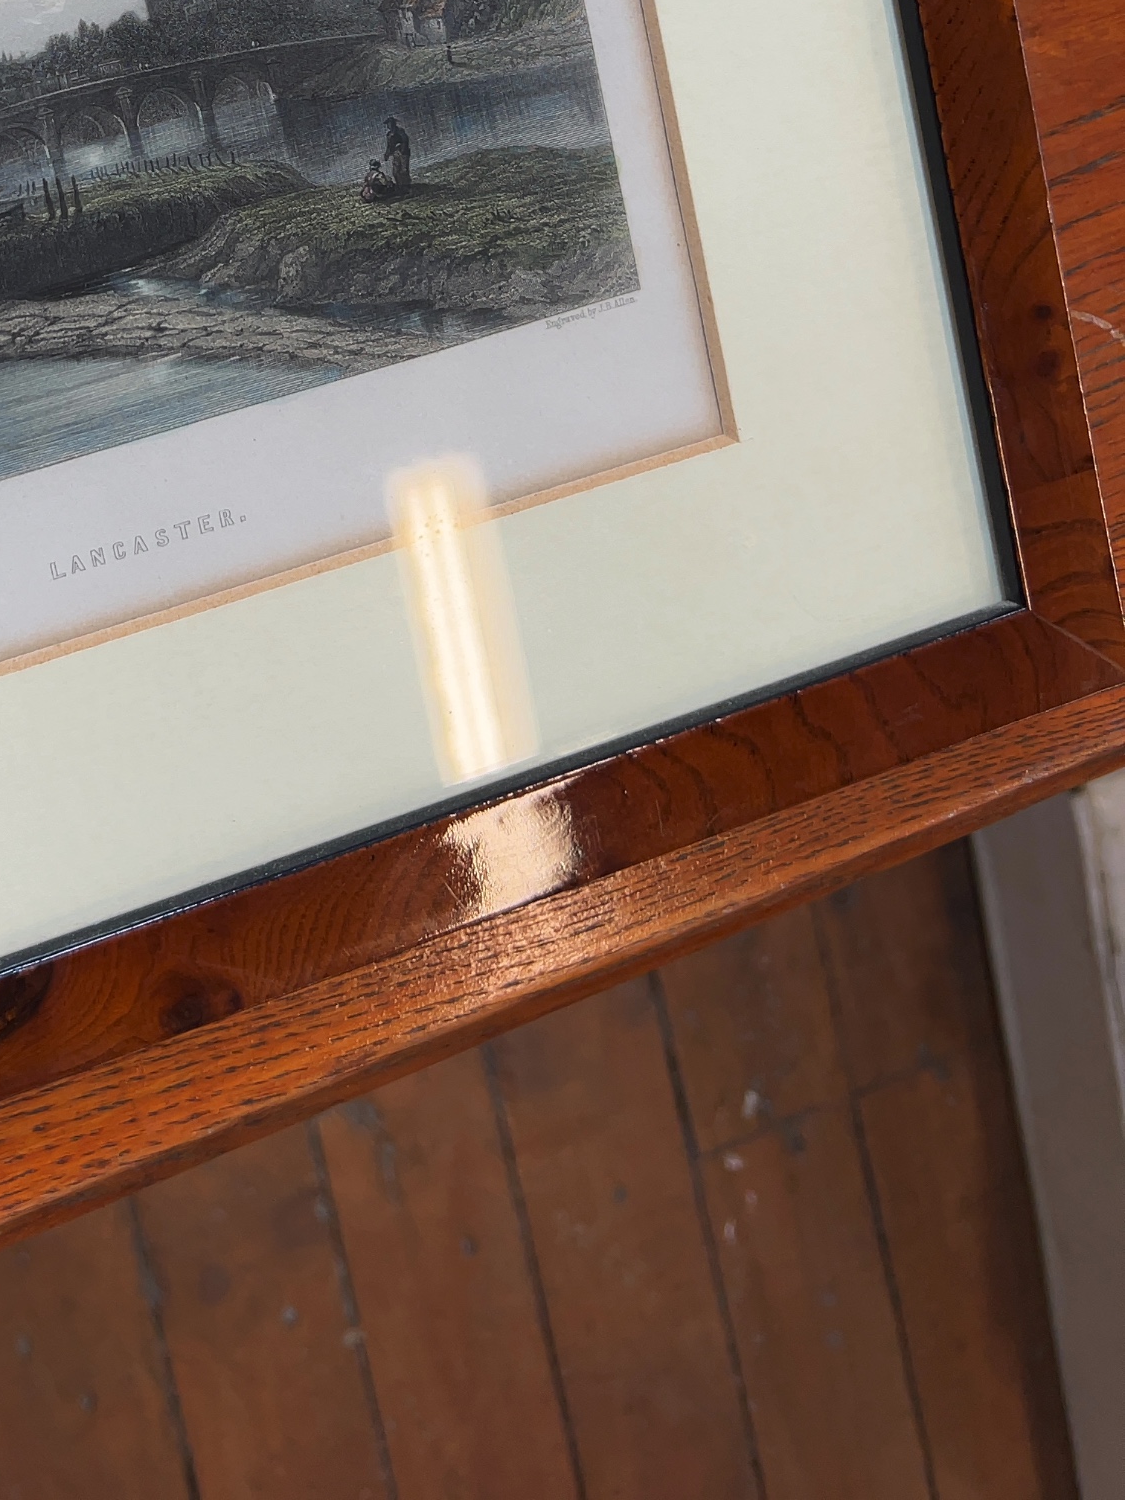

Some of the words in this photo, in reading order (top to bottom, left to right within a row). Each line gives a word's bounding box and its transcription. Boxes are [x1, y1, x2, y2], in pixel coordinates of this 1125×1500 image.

[545, 309, 586, 330] Engraved
[587, 307, 597, 319] by
[49, 508, 248, 580] LANCASTER.
